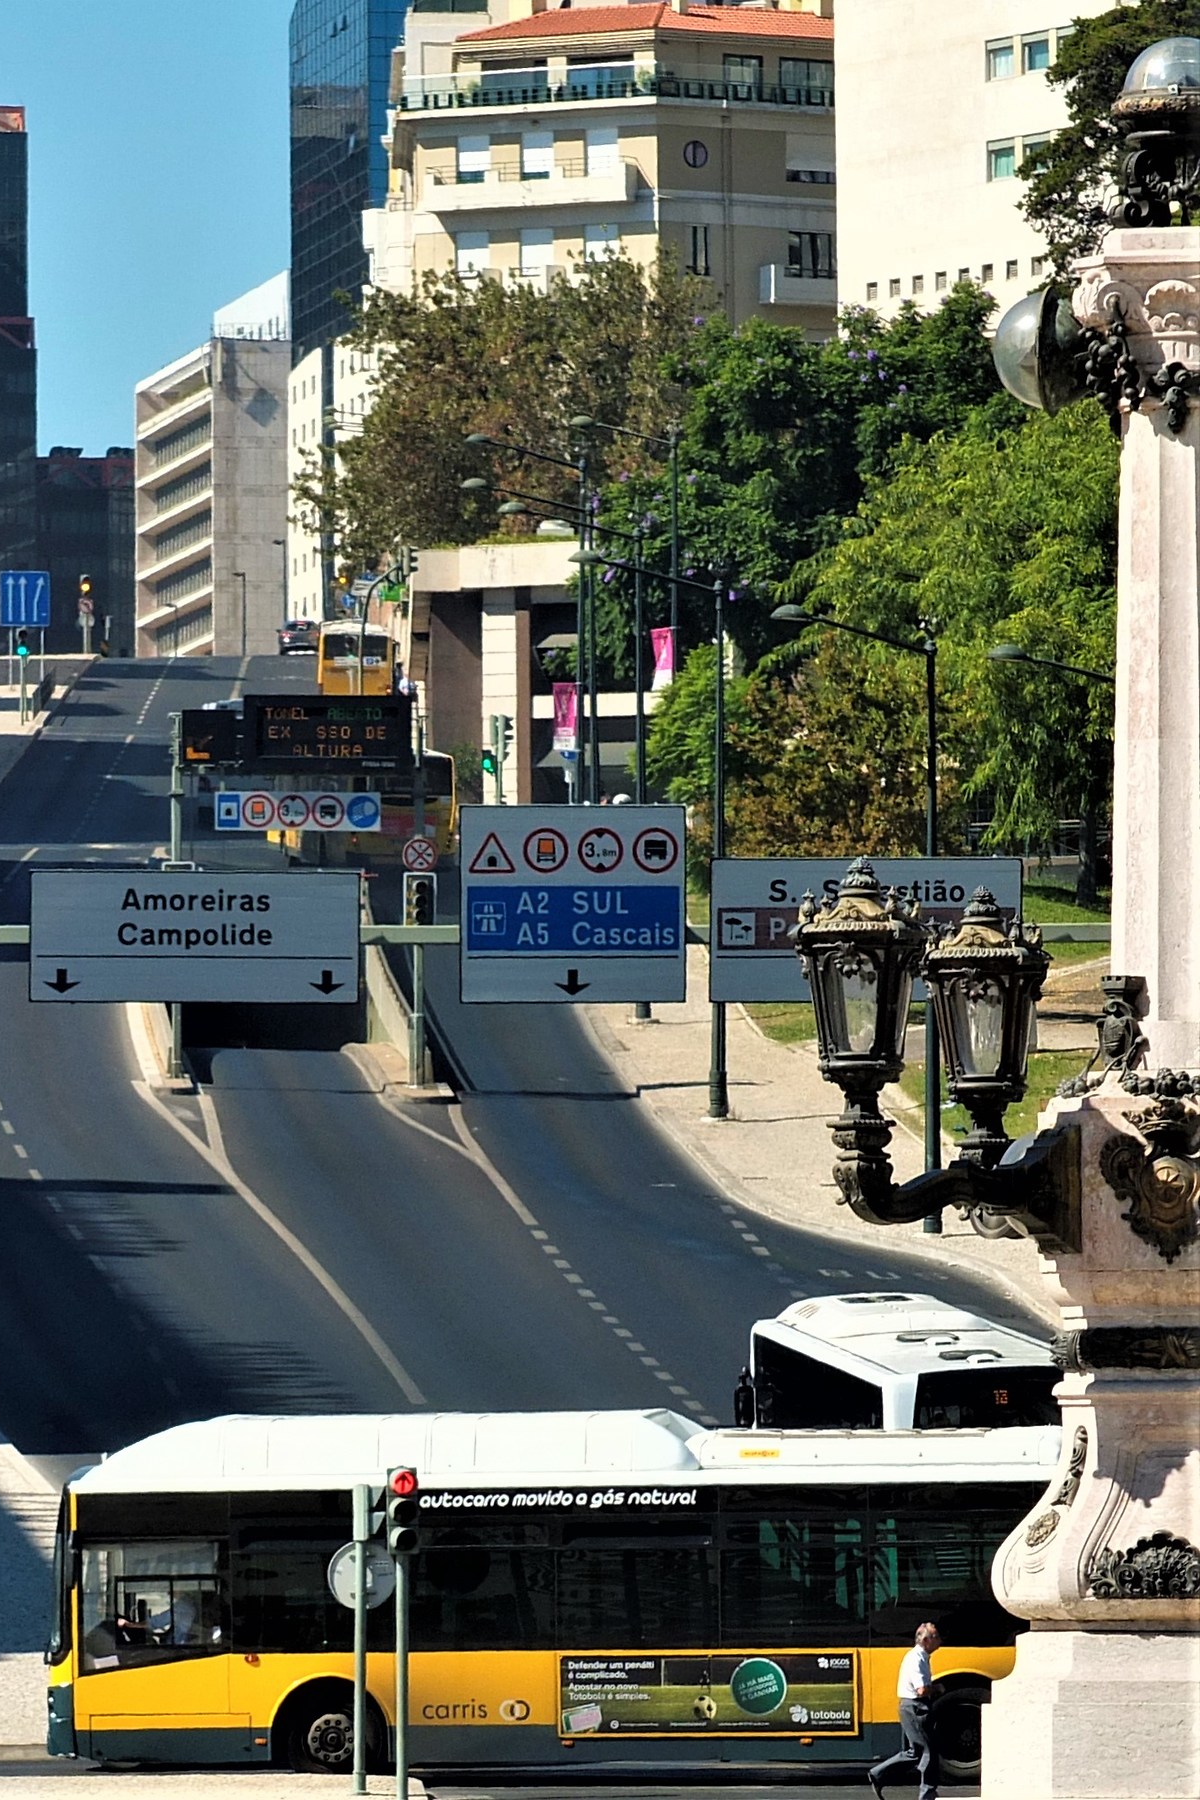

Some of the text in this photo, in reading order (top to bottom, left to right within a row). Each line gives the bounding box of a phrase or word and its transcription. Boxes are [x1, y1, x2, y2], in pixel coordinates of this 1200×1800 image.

[328, 708, 382, 720] ABETO
[365, 726, 386, 740] DE
[292, 744, 363, 757] ALTURA
[121, 888, 270, 912] Amoreiras
[768, 879, 797, 903] S.
[516, 891, 628, 914] A2 SUL
[117, 922, 273, 949] Campolide
[516, 921, 675, 945] A5 Cascais
[419, 1488, 697, 1509] autocarro movido a gás natural
[568, 1661, 608, 1669] Defender
[422, 1698, 488, 1720] carris
[810, 1710, 851, 1720] totobola
